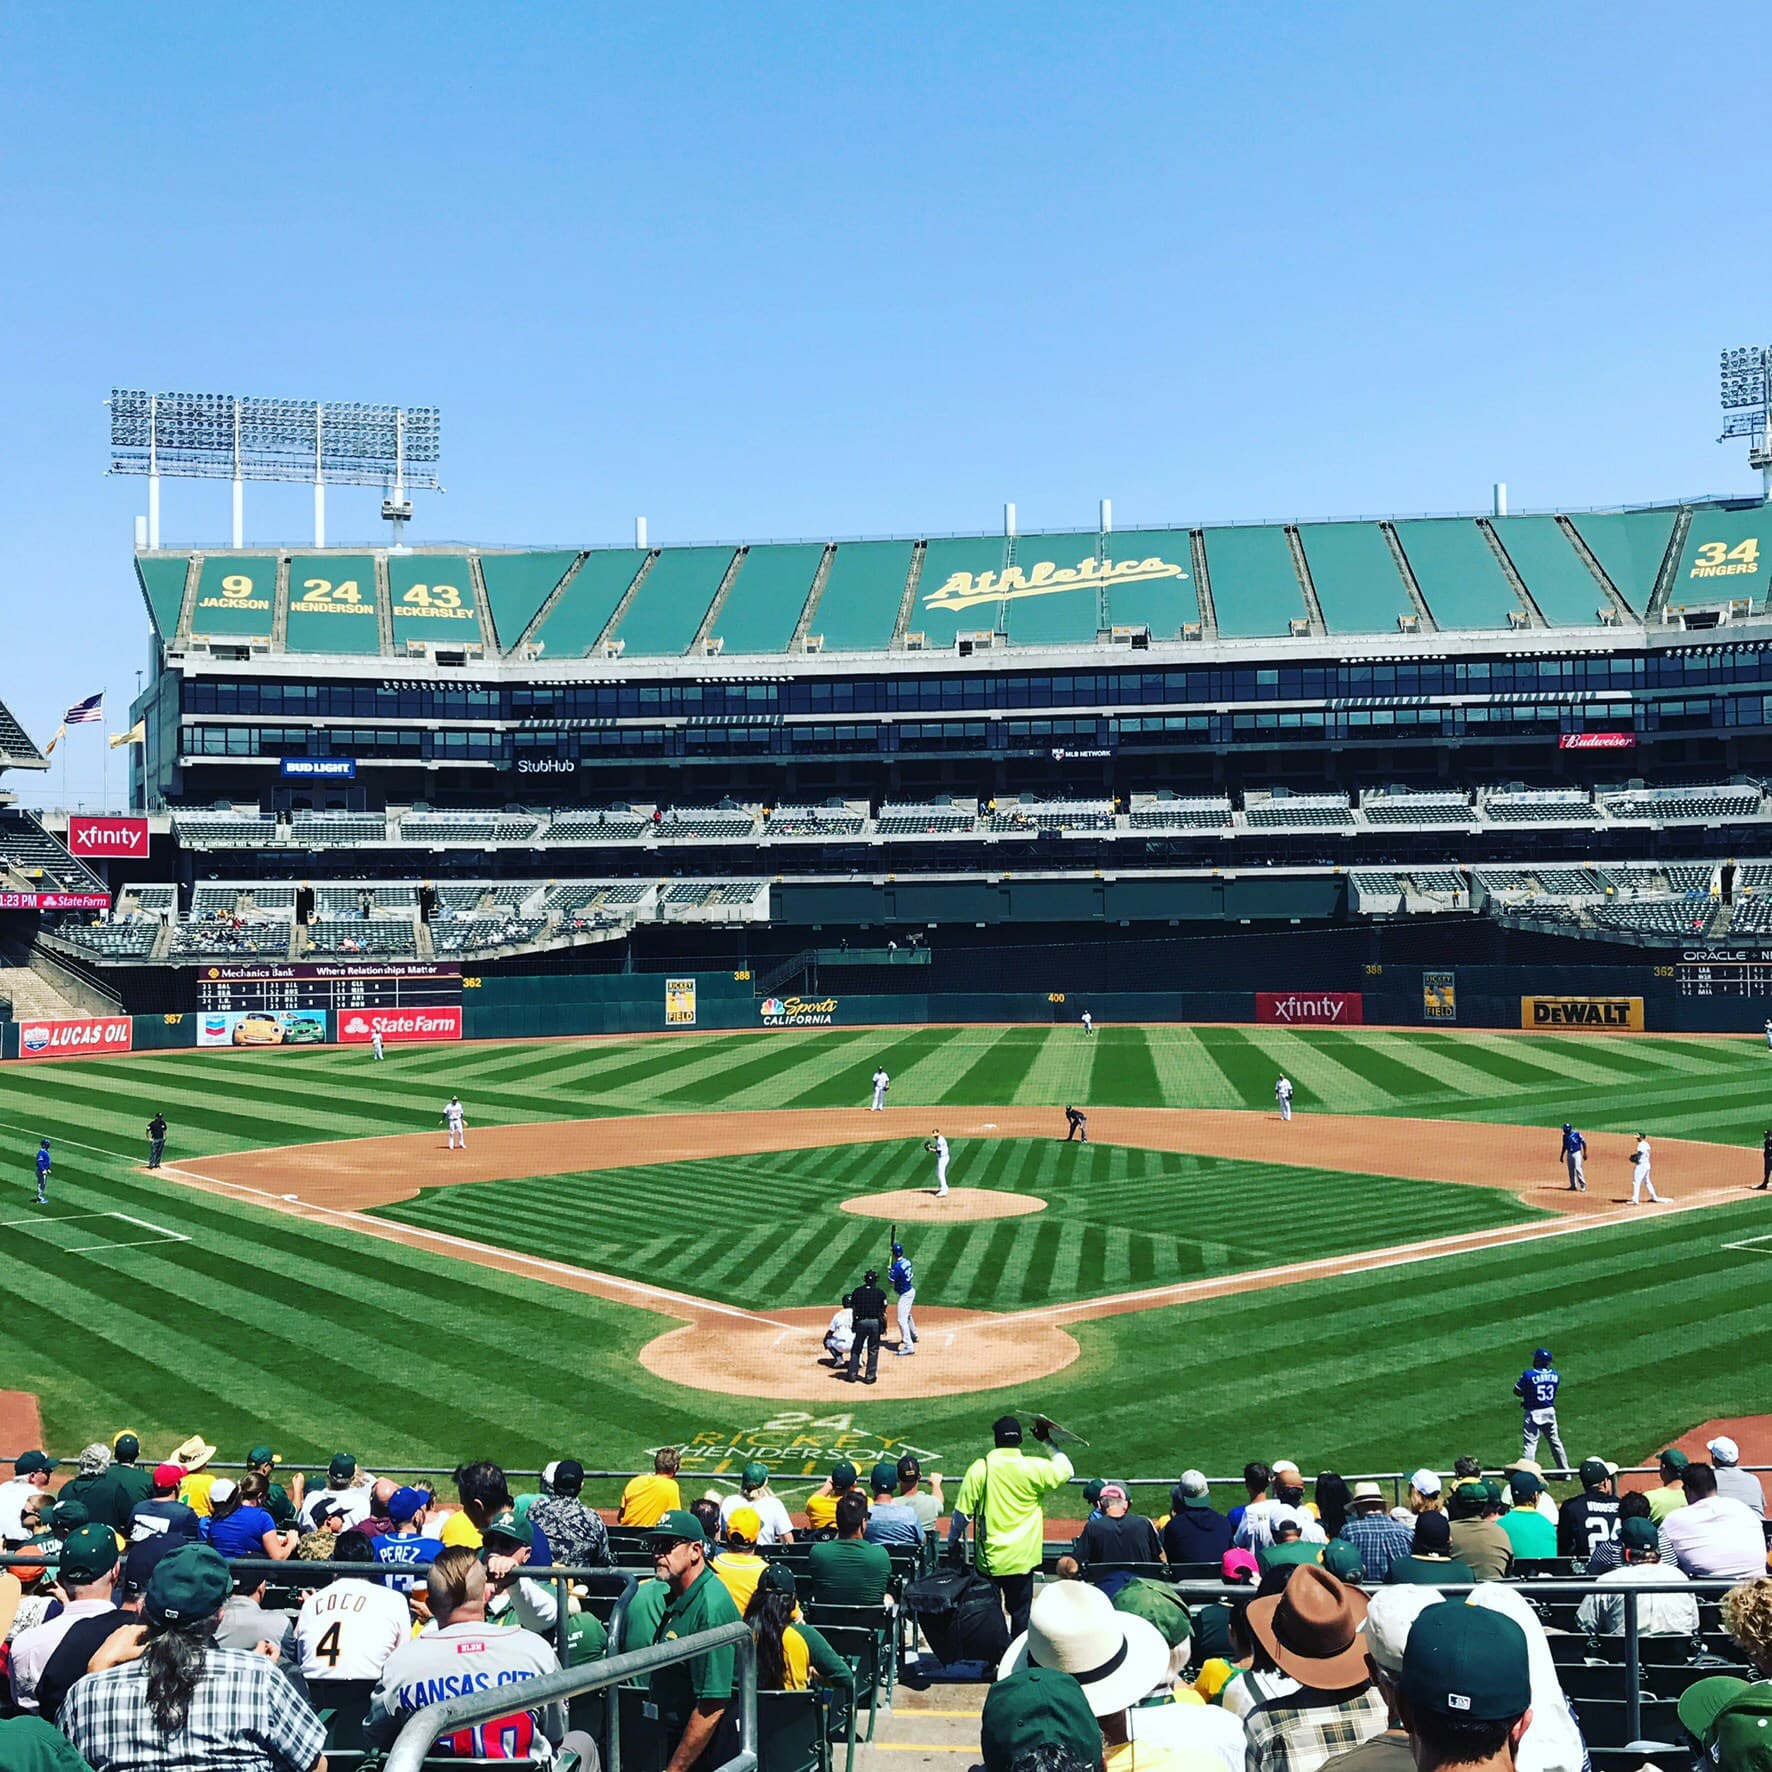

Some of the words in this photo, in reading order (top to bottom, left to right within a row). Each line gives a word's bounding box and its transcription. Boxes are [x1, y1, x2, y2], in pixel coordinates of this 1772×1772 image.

[1694, 538, 1760, 567] 34
[1690, 562, 1758, 579] FINGERS
[222, 575, 253, 598] 9
[922, 557, 1168, 602] Athletics
[303, 579, 362, 603] 24
[403, 584, 462, 608] 43
[199, 597, 269, 610] JACKSON
[291, 601, 374, 614] HENDERSON
[393, 606, 474, 619] ECKERSLEY
[1562, 734, 1633, 748] Budweiser
[286, 763, 313, 772] BUD
[313, 763, 350, 773] LIGHT
[518, 759, 575, 773] StubHub
[77, 825, 141, 849] xfinity
[22, 895, 37, 907] PM
[1683, 951, 1747, 960] ORACLE
[221, 968, 269, 978] Mechanics
[272, 967, 294, 977] Bank
[316, 967, 344, 976] Where
[347, 966, 406, 976] Relationships
[408, 965, 437, 975] Matter
[734, 971, 750, 981] 388
[1654, 966, 1674, 977] 362
[463, 978, 482, 988] 362
[1048, 993, 1065, 1003] 400
[784, 996, 838, 1017] Sports
[1275, 997, 1344, 1021] xfinity
[1427, 1007, 1453, 1017] FIELD
[164, 1013, 183, 1025] 367
[668, 1011, 693, 1022] FIELD
[763, 1015, 832, 1025] CALIFORNIA
[50, 1025, 102, 1046] LUCAS
[104, 1024, 128, 1043] OIL
[1537, 1384, 1554, 1401] 53
[763, 1411, 855, 1431] 24
[691, 1431, 909, 1449] RICKEY
[679, 1445, 908, 1461] HENDERSON
[379, 1545, 421, 1564] PEREZ
[315, 1593, 367, 1616] COCO
[315, 1621, 342, 1667] 4
[399, 1672, 489, 1712] KANSAS
[497, 1670, 536, 1687] CIT
